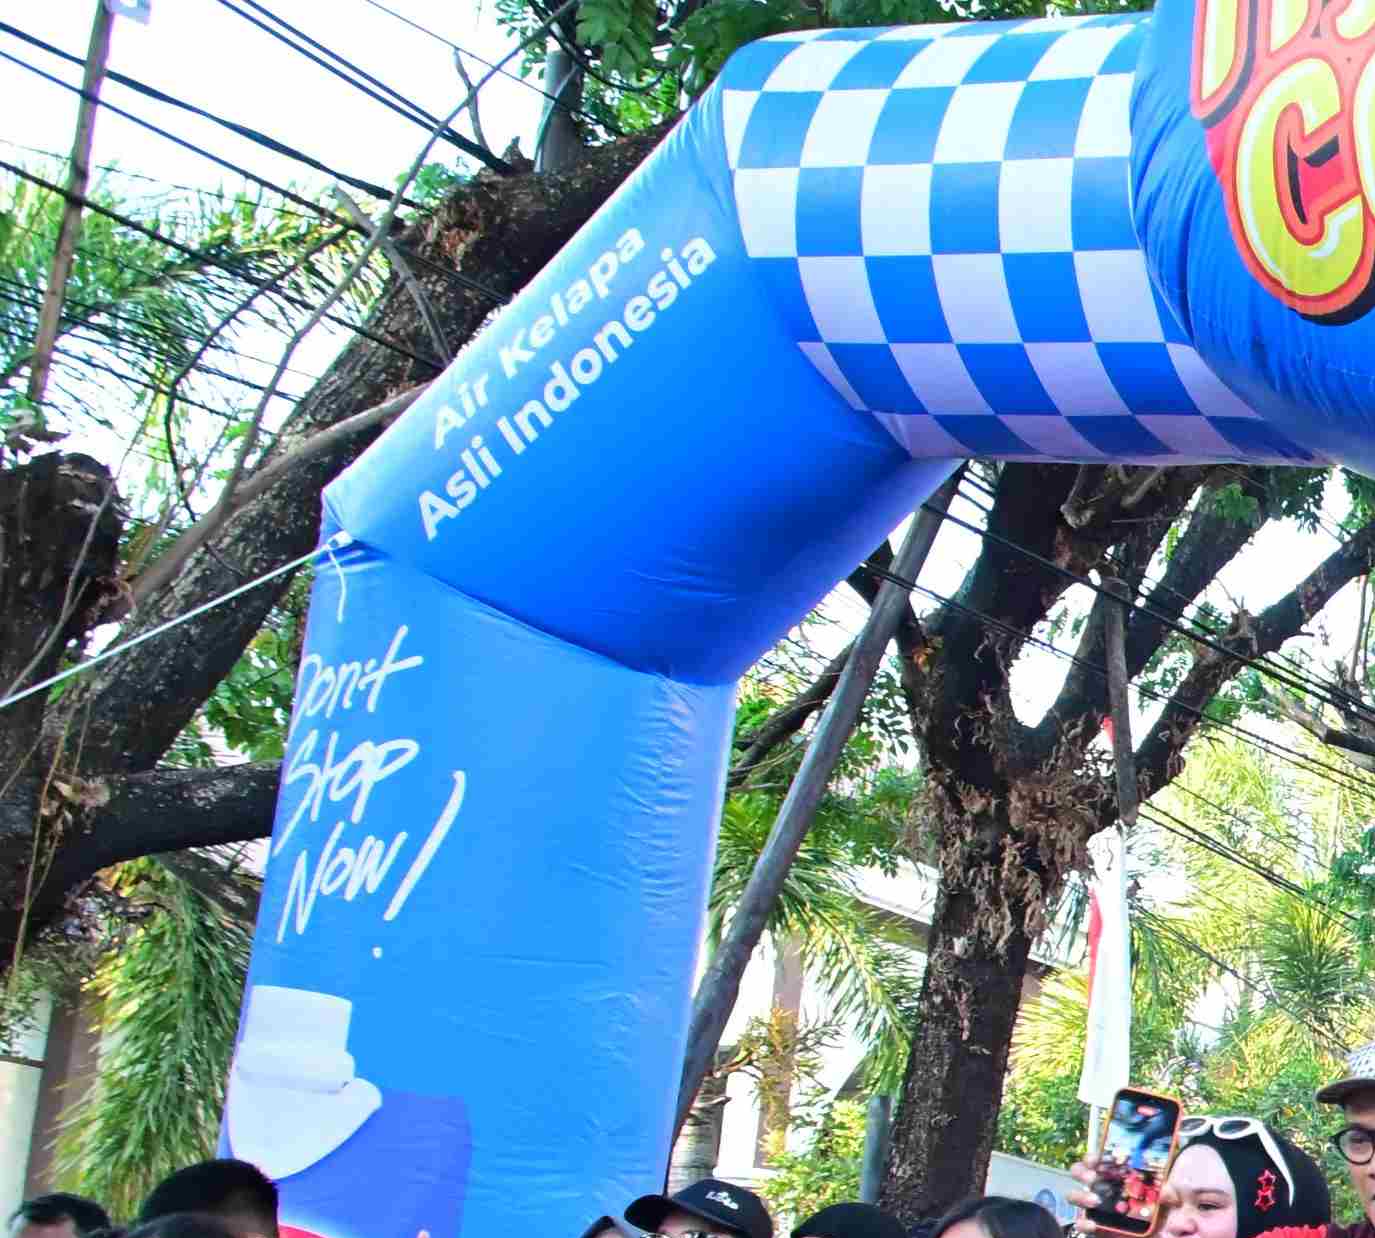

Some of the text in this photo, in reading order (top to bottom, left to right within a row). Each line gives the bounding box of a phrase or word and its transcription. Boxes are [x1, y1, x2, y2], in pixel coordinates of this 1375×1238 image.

[417, 233, 717, 540] Asli Indonesia
[432, 226, 646, 449] Air Kelapa
